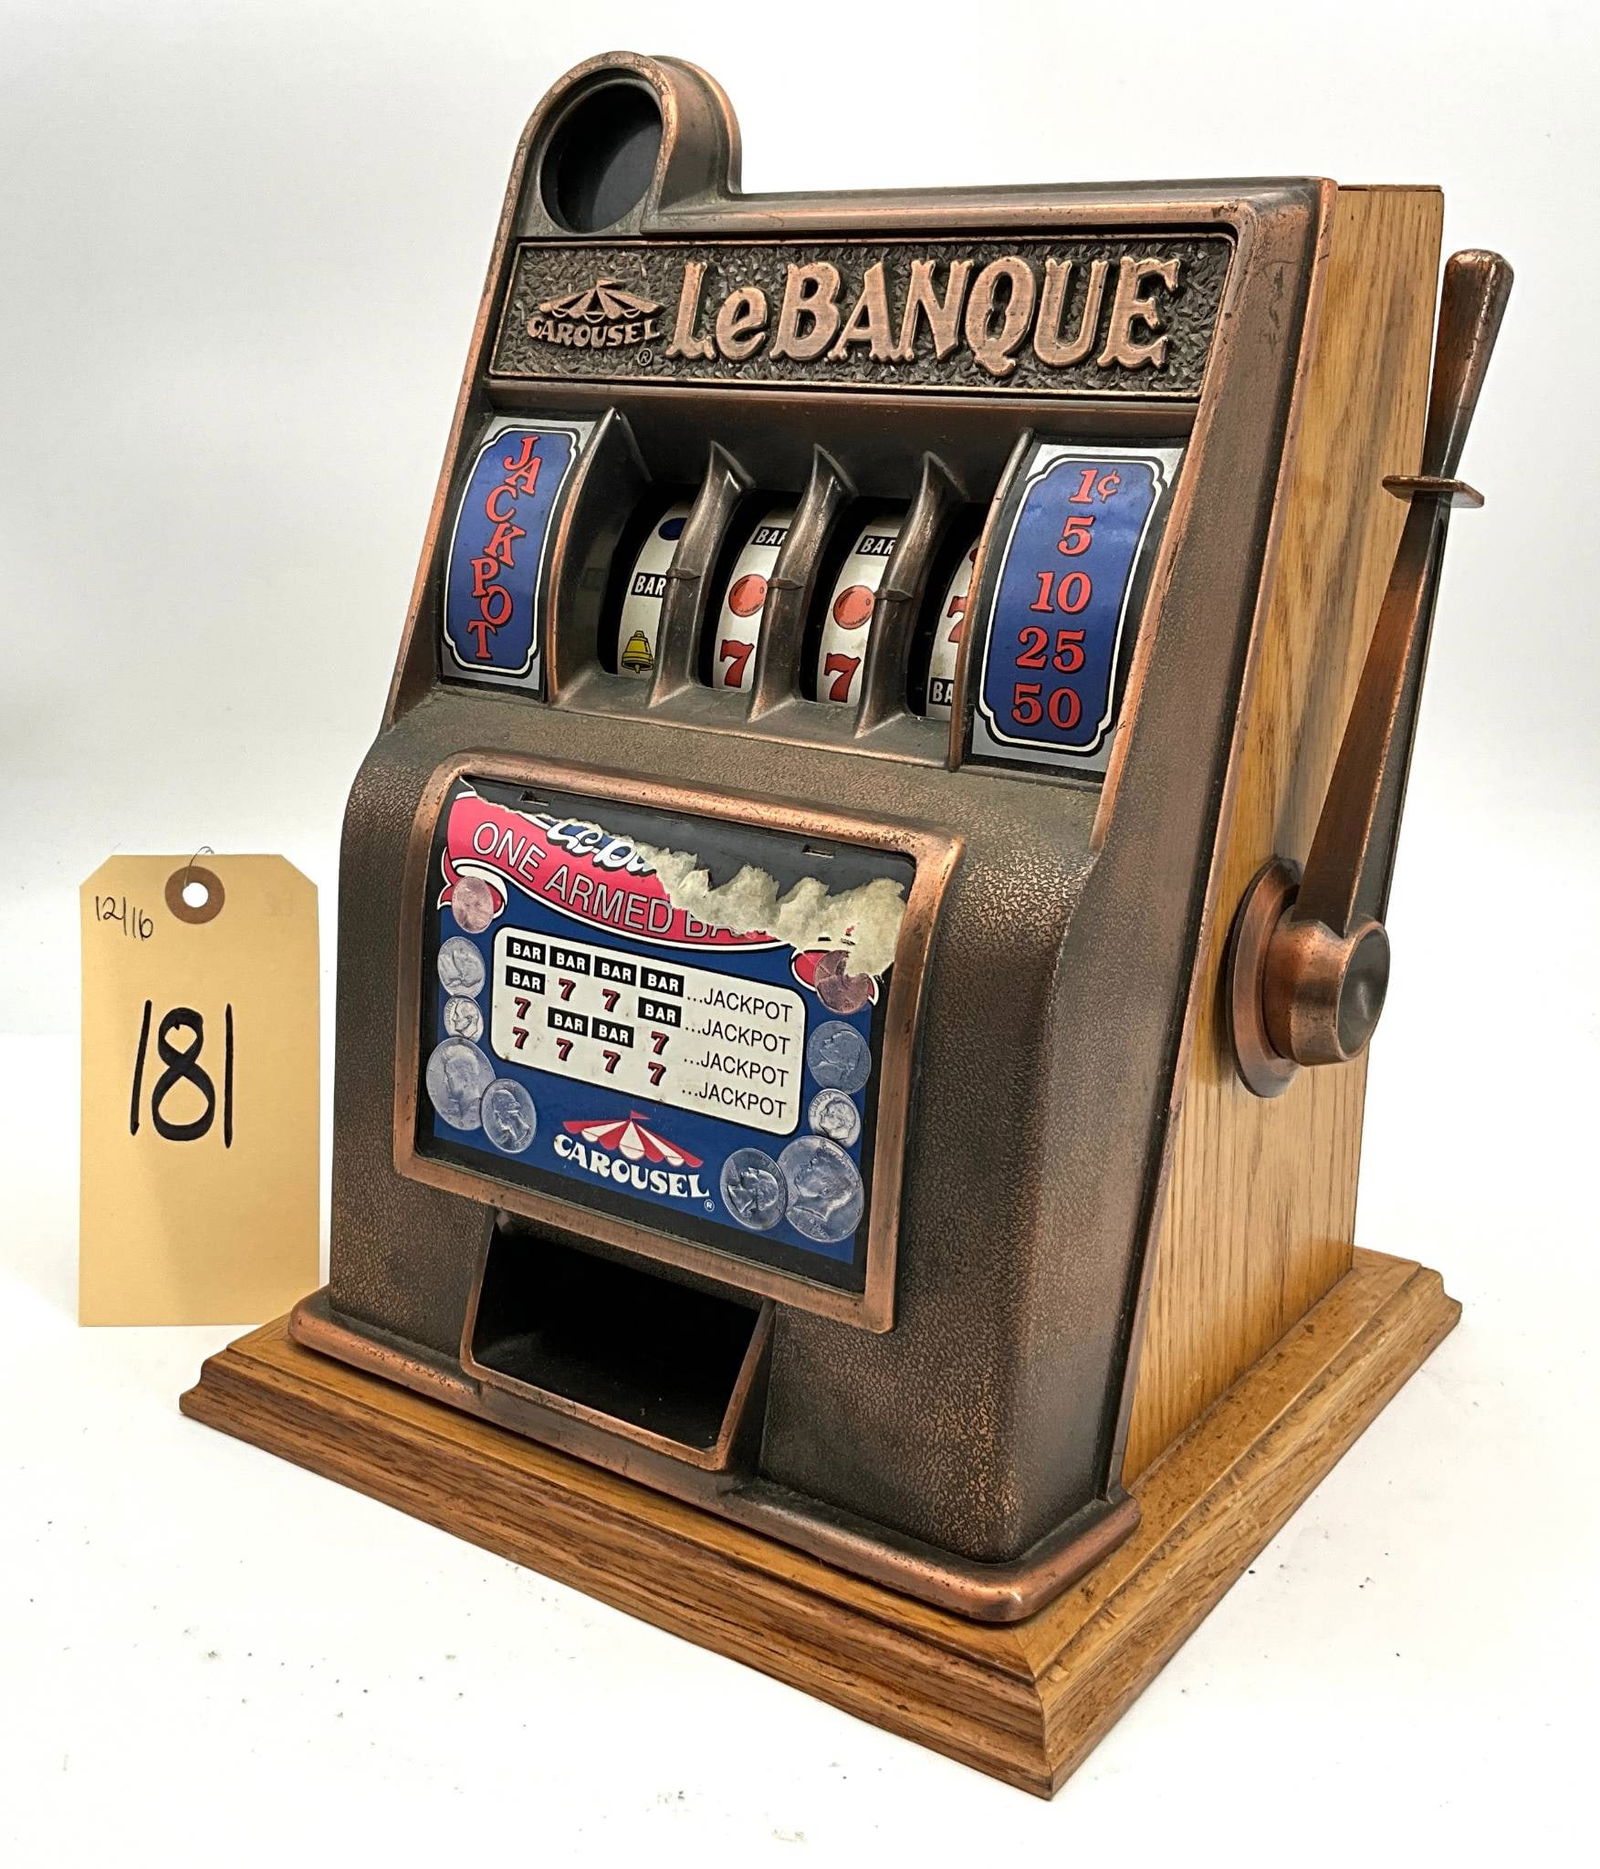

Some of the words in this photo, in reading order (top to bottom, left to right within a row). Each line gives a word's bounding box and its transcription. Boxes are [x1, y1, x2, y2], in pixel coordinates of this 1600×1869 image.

[526, 314, 661, 348] CAROUSEL
[467, 434, 543, 660] JACKPOT
[1057, 515, 1096, 556] 5
[634, 575, 666, 595] BAR
[1029, 571, 1093, 614] 10
[719, 639, 755, 688] 7
[1015, 626, 1087, 673] 25
[824, 653, 861, 703] 7
[1011, 683, 1082, 729] 50
[472, 821, 546, 882] ONE
[543, 865, 674, 934] ARMED
[513, 942, 541, 961] BAR
[556, 952, 586, 971] BAR
[601, 962, 632, 982] BAR
[647, 973, 679, 993] BAR
[512, 972, 541, 990] BAR
[558, 978, 576, 1001] 7
[602, 989, 621, 1013] 7
[645, 1003, 676, 1023] BAR
[514, 996, 531, 1020] 7
[554, 1013, 583, 1032] BAR
[599, 1025, 629, 1044] BAR
[651, 1031, 670, 1055] 7
[130, 999, 233, 1149] 181
[512, 1026, 529, 1050] 7
[556, 1038, 573, 1061] 7
[603, 1050, 621, 1074] 7
[648, 1061, 667, 1086] 7
[553, 1133, 710, 1198] CAROUSEL
